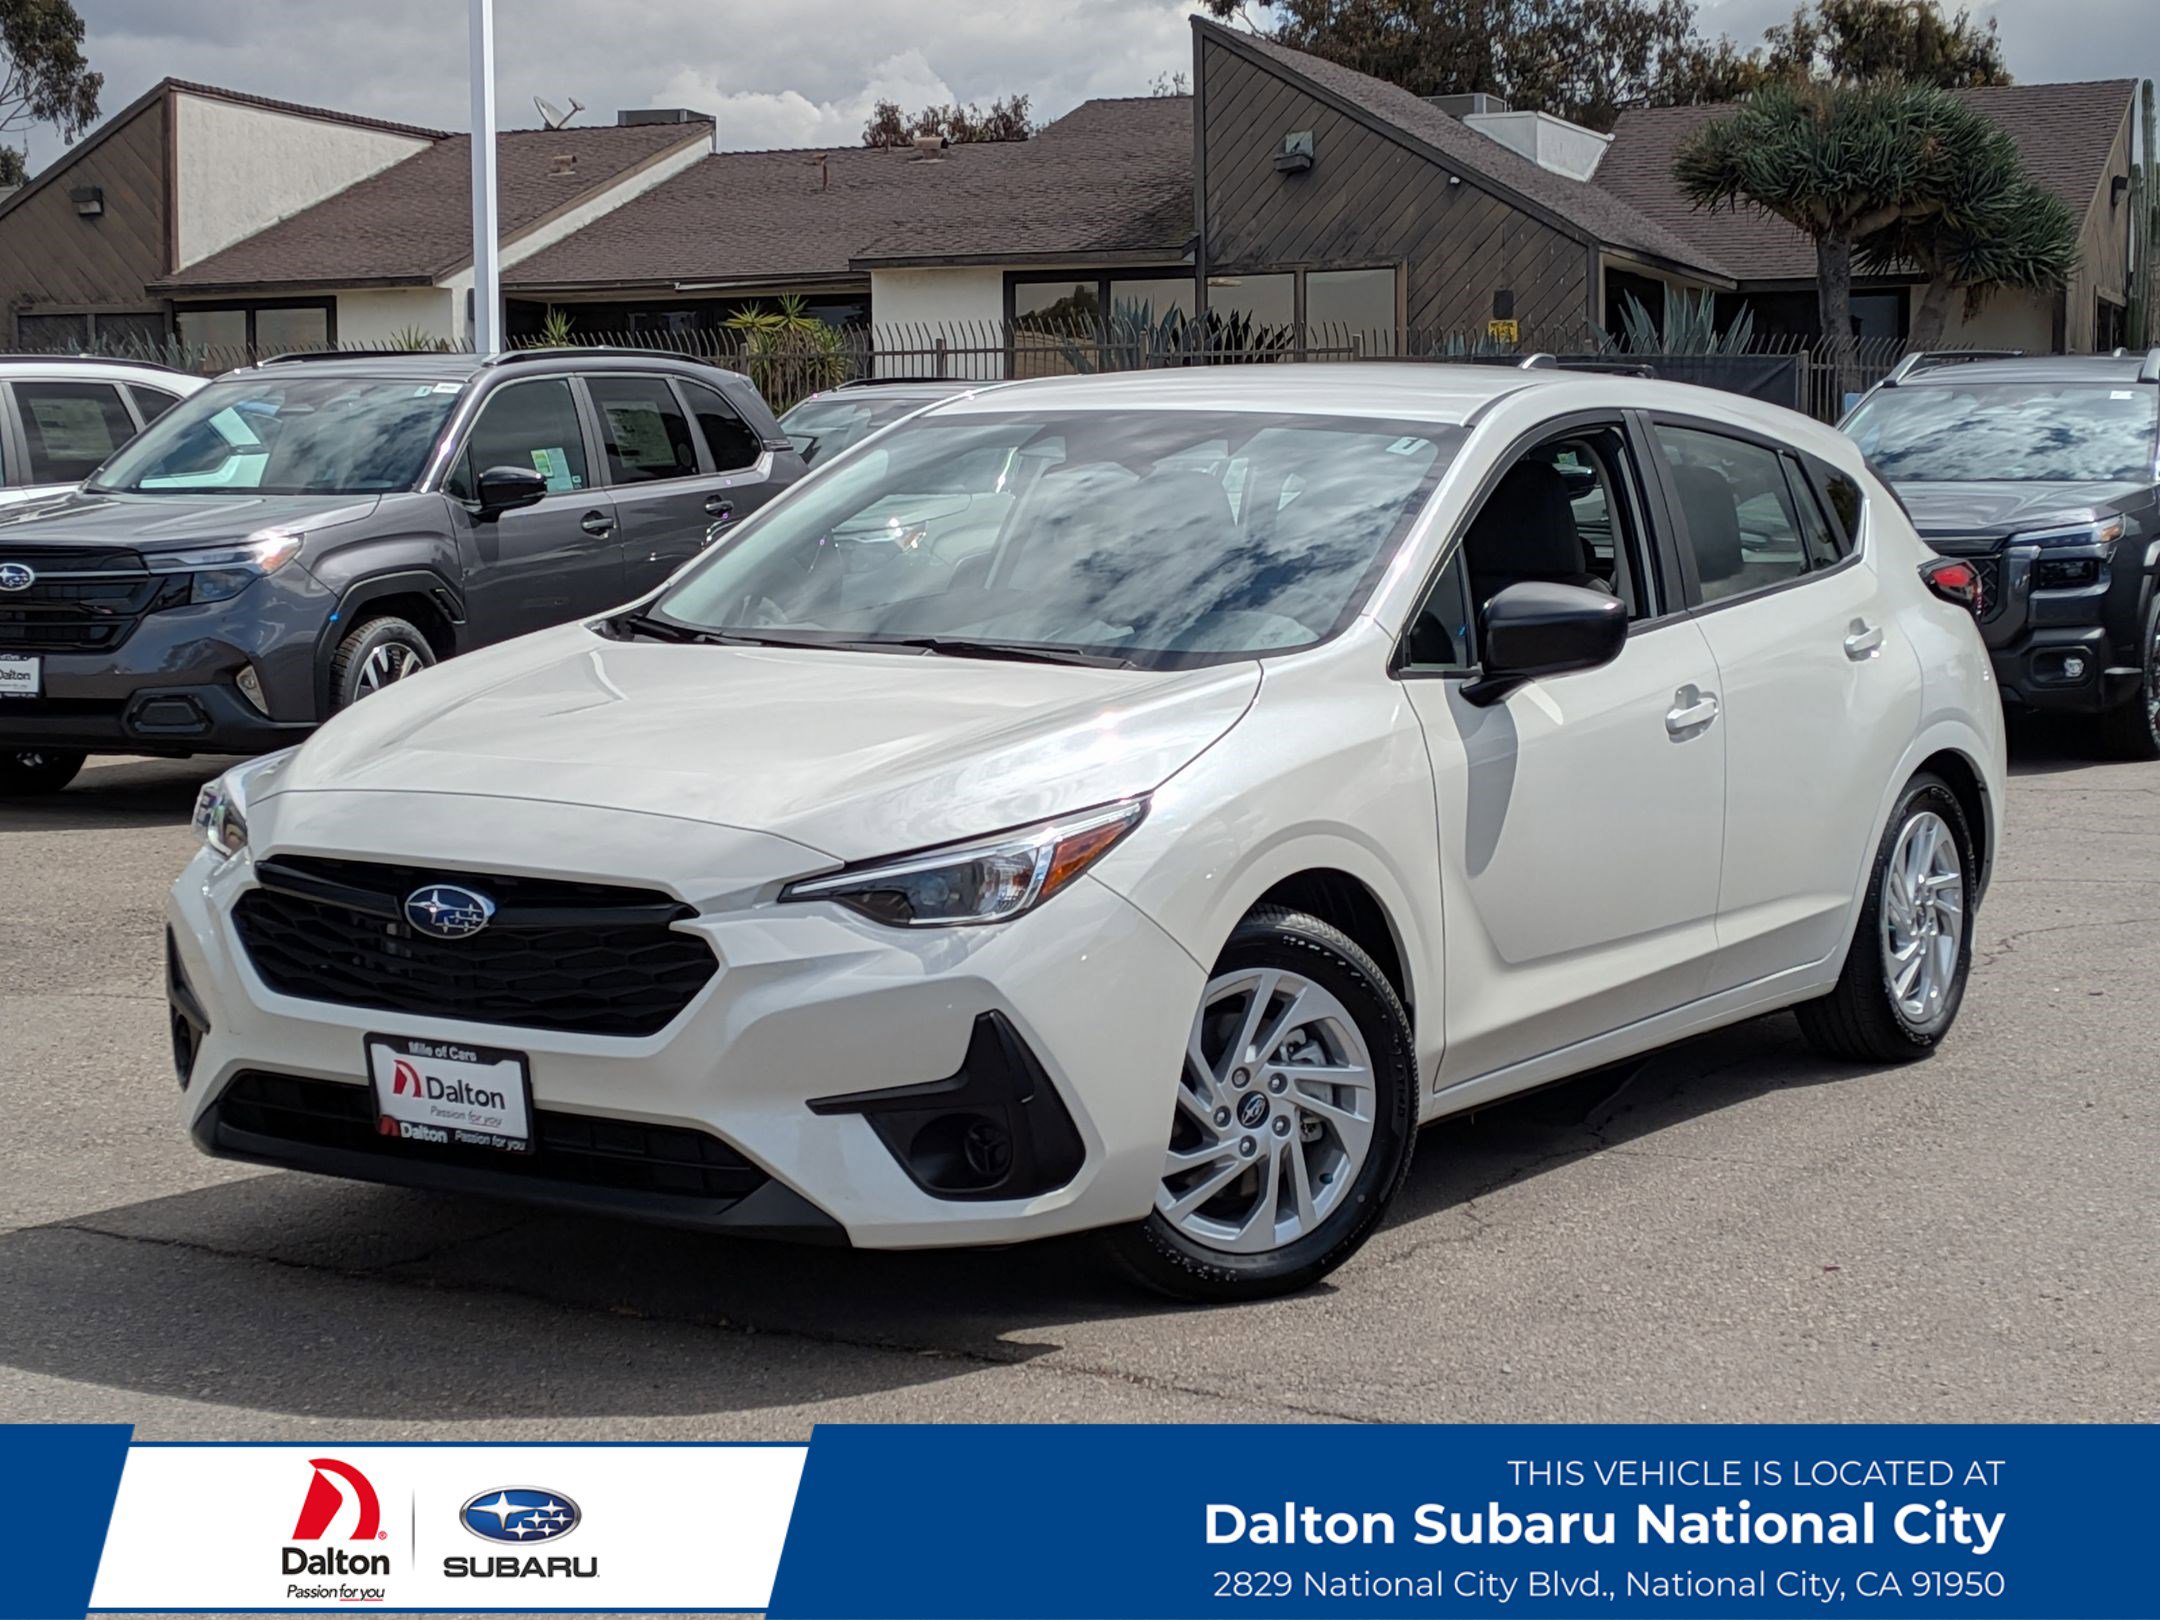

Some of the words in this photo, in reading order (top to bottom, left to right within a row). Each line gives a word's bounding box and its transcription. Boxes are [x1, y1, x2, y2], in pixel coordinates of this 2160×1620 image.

[408, 1041, 433, 1057] Mile
[434, 1046, 448, 1059] of
[449, 1047, 478, 1062] Cars
[425, 1076, 506, 1110] Dalton
[430, 1105, 467, 1120] Passion
[468, 1111, 482, 1124] for
[482, 1117, 503, 1127] you
[400, 1122, 449, 1144] Dalton
[454, 1130, 491, 1145] Passion
[492, 1135, 506, 1148] for
[506, 1140, 527, 1151] you
